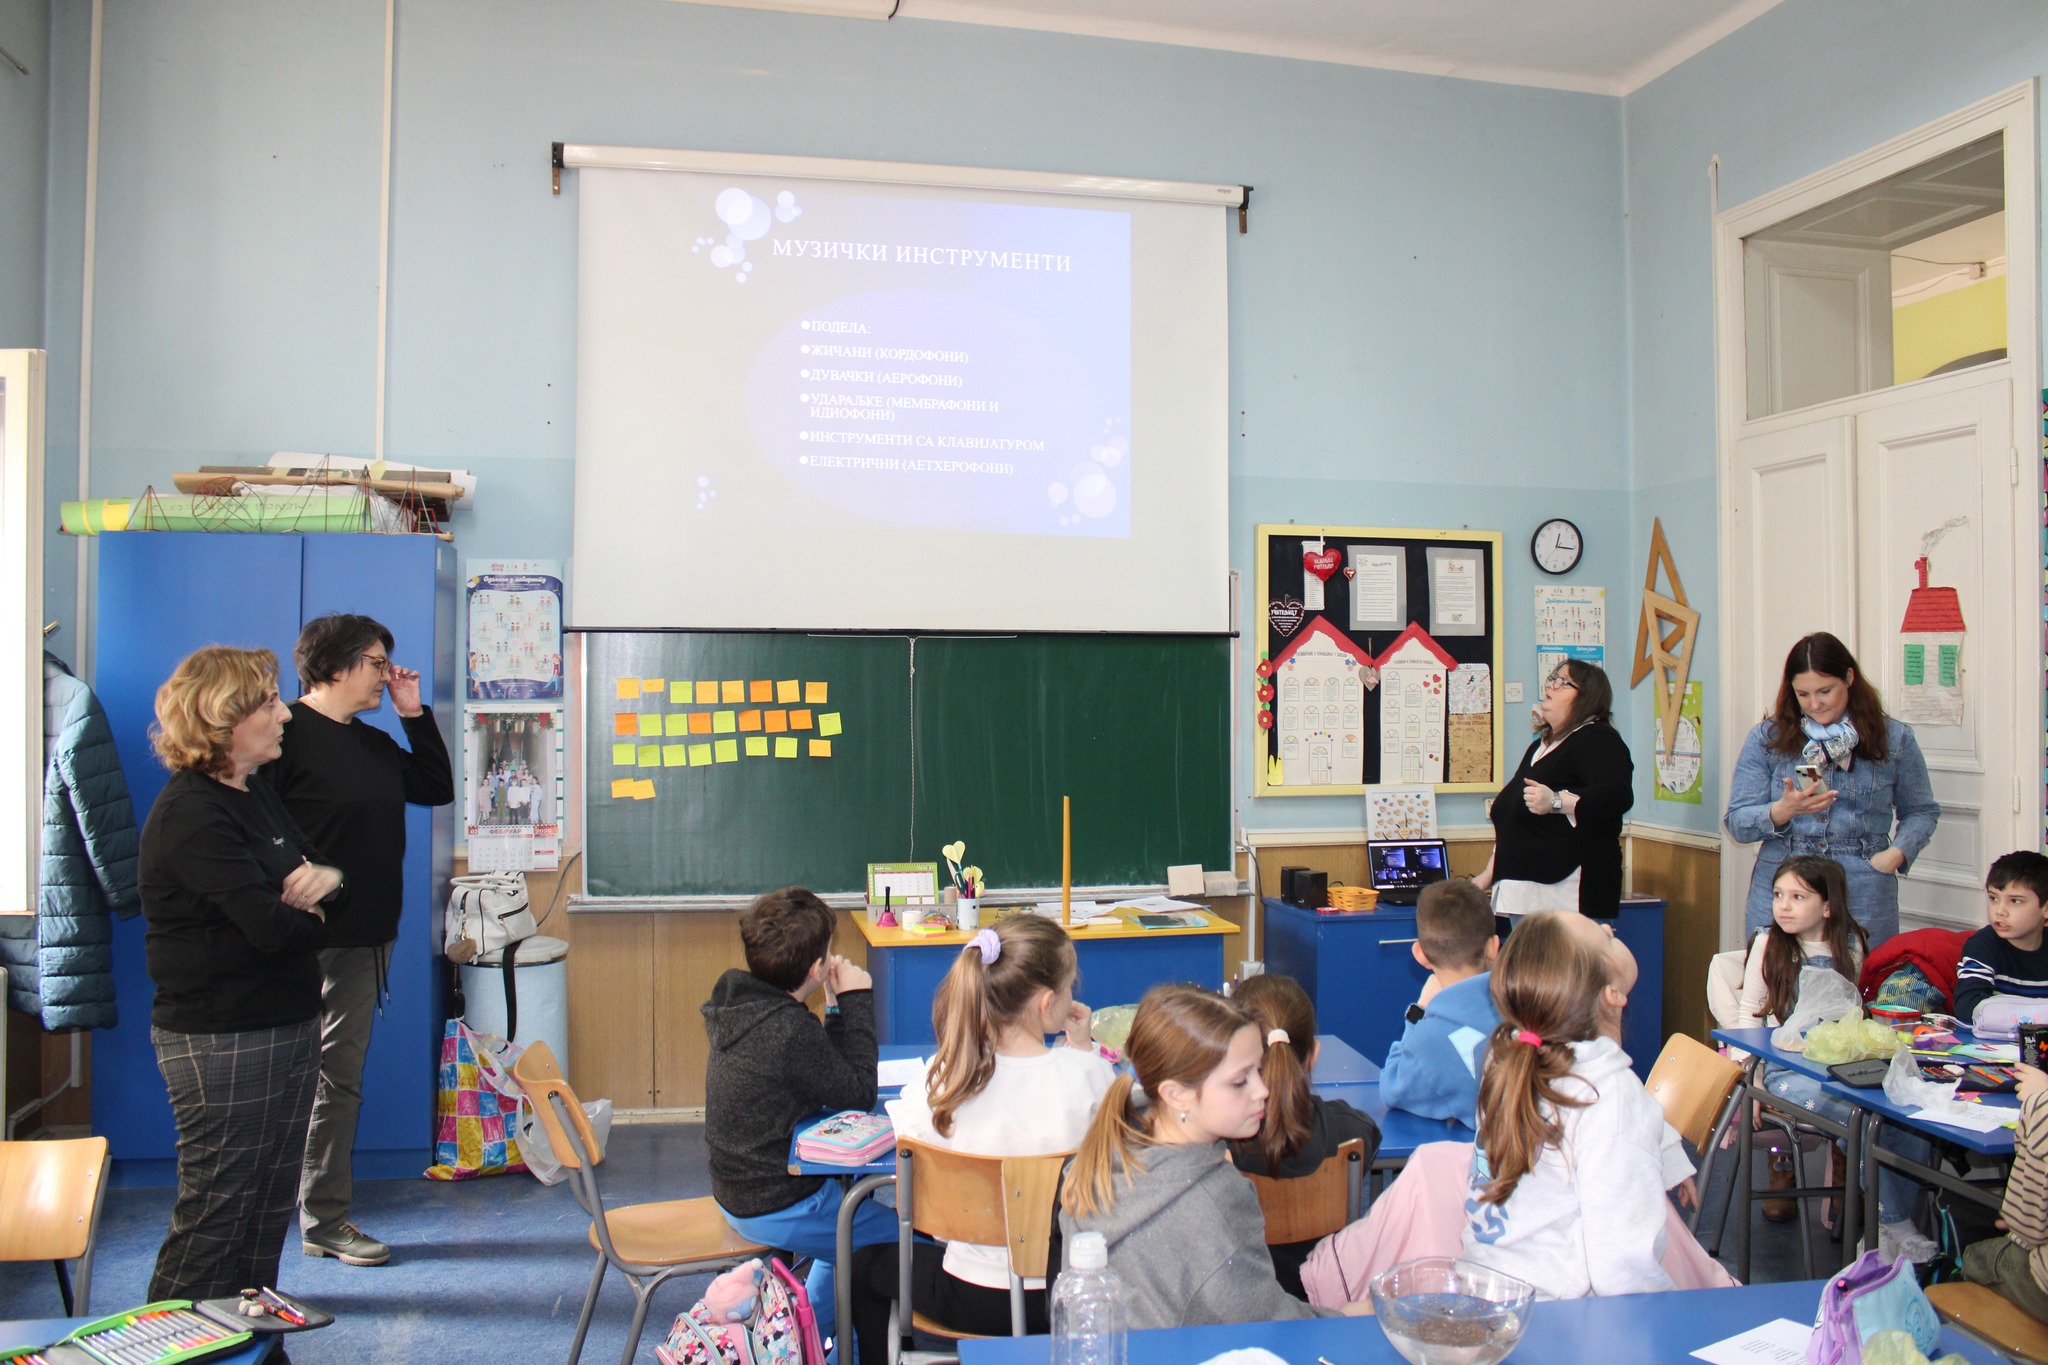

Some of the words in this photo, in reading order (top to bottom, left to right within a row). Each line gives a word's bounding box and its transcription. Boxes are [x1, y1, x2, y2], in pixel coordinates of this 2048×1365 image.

[772, 239, 888, 262] МУЗИЧКИ
[895, 245, 1072, 272] ИНСТРУМЕНТИ
[811, 320, 871, 335] ПОДЕЛА:
[810, 344, 872, 358] ЖИЧАНИ
[875, 348, 969, 364] (КОРДОФОНИ)
[810, 369, 874, 383] ДУВАЧКИ
[877, 372, 963, 388] (АЕРОФОНИ)
[810, 393, 884, 408] УДАРАЉКЕ
[886, 397, 986, 412] (МЕМБРАФОНИ
[988, 400, 999, 412] И
[810, 408, 895, 422] ИДИОФОНИ)
[809, 430, 913, 446] ИНСТРУМЕНТИ
[916, 435, 934, 447] СА
[937, 436, 1045, 451] КЛАВИЈАТУРОМ
[809, 455, 899, 470] ЕЛЕКТРИЧНИ
[902, 459, 1014, 476] (АЕТХЕРОФОНИ)
